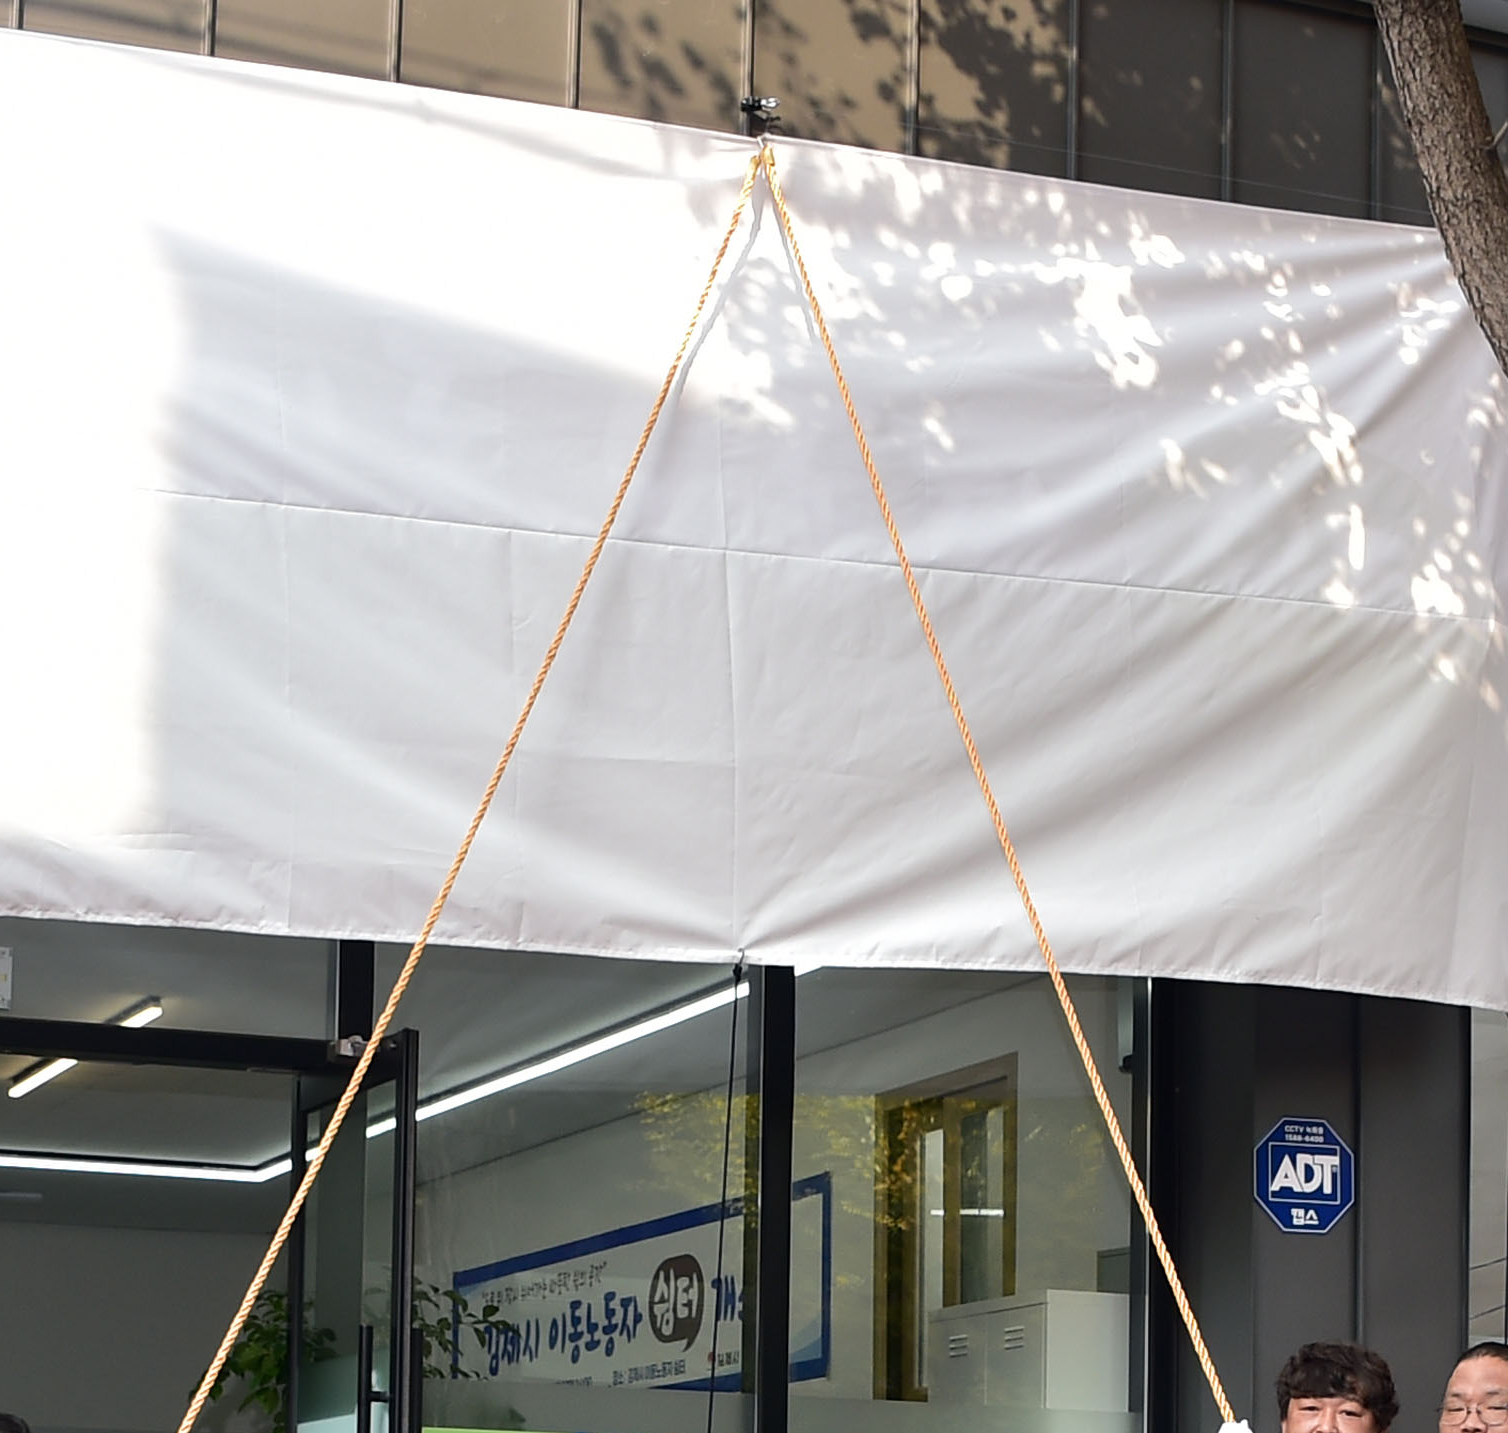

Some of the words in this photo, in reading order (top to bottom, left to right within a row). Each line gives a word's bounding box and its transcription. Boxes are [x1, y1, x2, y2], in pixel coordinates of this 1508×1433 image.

[1270, 1153, 1339, 1194] ADT
[548, 1291, 643, 1364] 이동노동자
[653, 1267, 699, 1336] 쉼터
